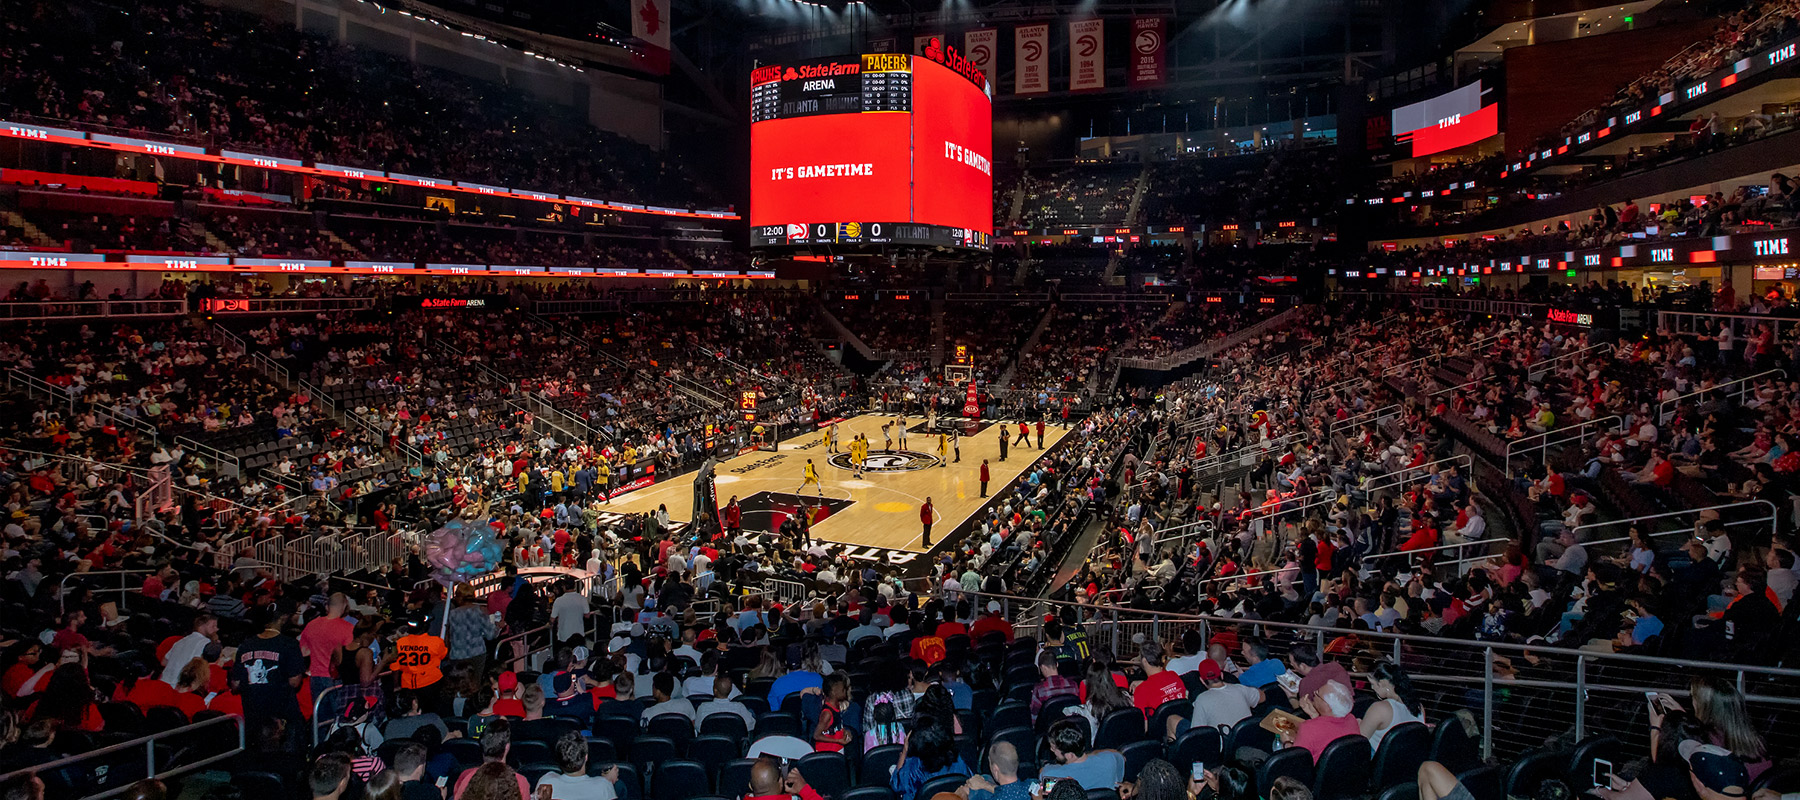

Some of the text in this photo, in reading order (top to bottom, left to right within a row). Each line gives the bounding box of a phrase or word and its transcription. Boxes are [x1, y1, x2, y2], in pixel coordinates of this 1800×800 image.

[1768, 44, 1796, 65] TIME
[803, 80, 835, 91] ARENA
[1687, 82, 1708, 98] TIME
[783, 100, 818, 114] ATLANTA
[1438, 113, 1461, 129] TIME
[10, 127, 47, 139] TIME
[145, 144, 174, 154] TIME
[944, 141, 962, 162] IT'S
[253, 158, 278, 168] TIME
[344, 169, 364, 178] TIME
[772, 163, 873, 180] IT'S GAMETIME
[763, 227, 783, 236] 12:00
[817, 224, 826, 237] 0
[872, 223, 881, 236] 0
[896, 226, 929, 239] ATLANTA
[1754, 238, 1789, 256] TIME
[30, 257, 67, 266] TIME
[1651, 248, 1674, 262] TIME
[165, 260, 197, 269] TIME
[743, 398, 754, 408] 24
[1077, 641, 1090, 659] 11
[398, 652, 431, 666] 230
